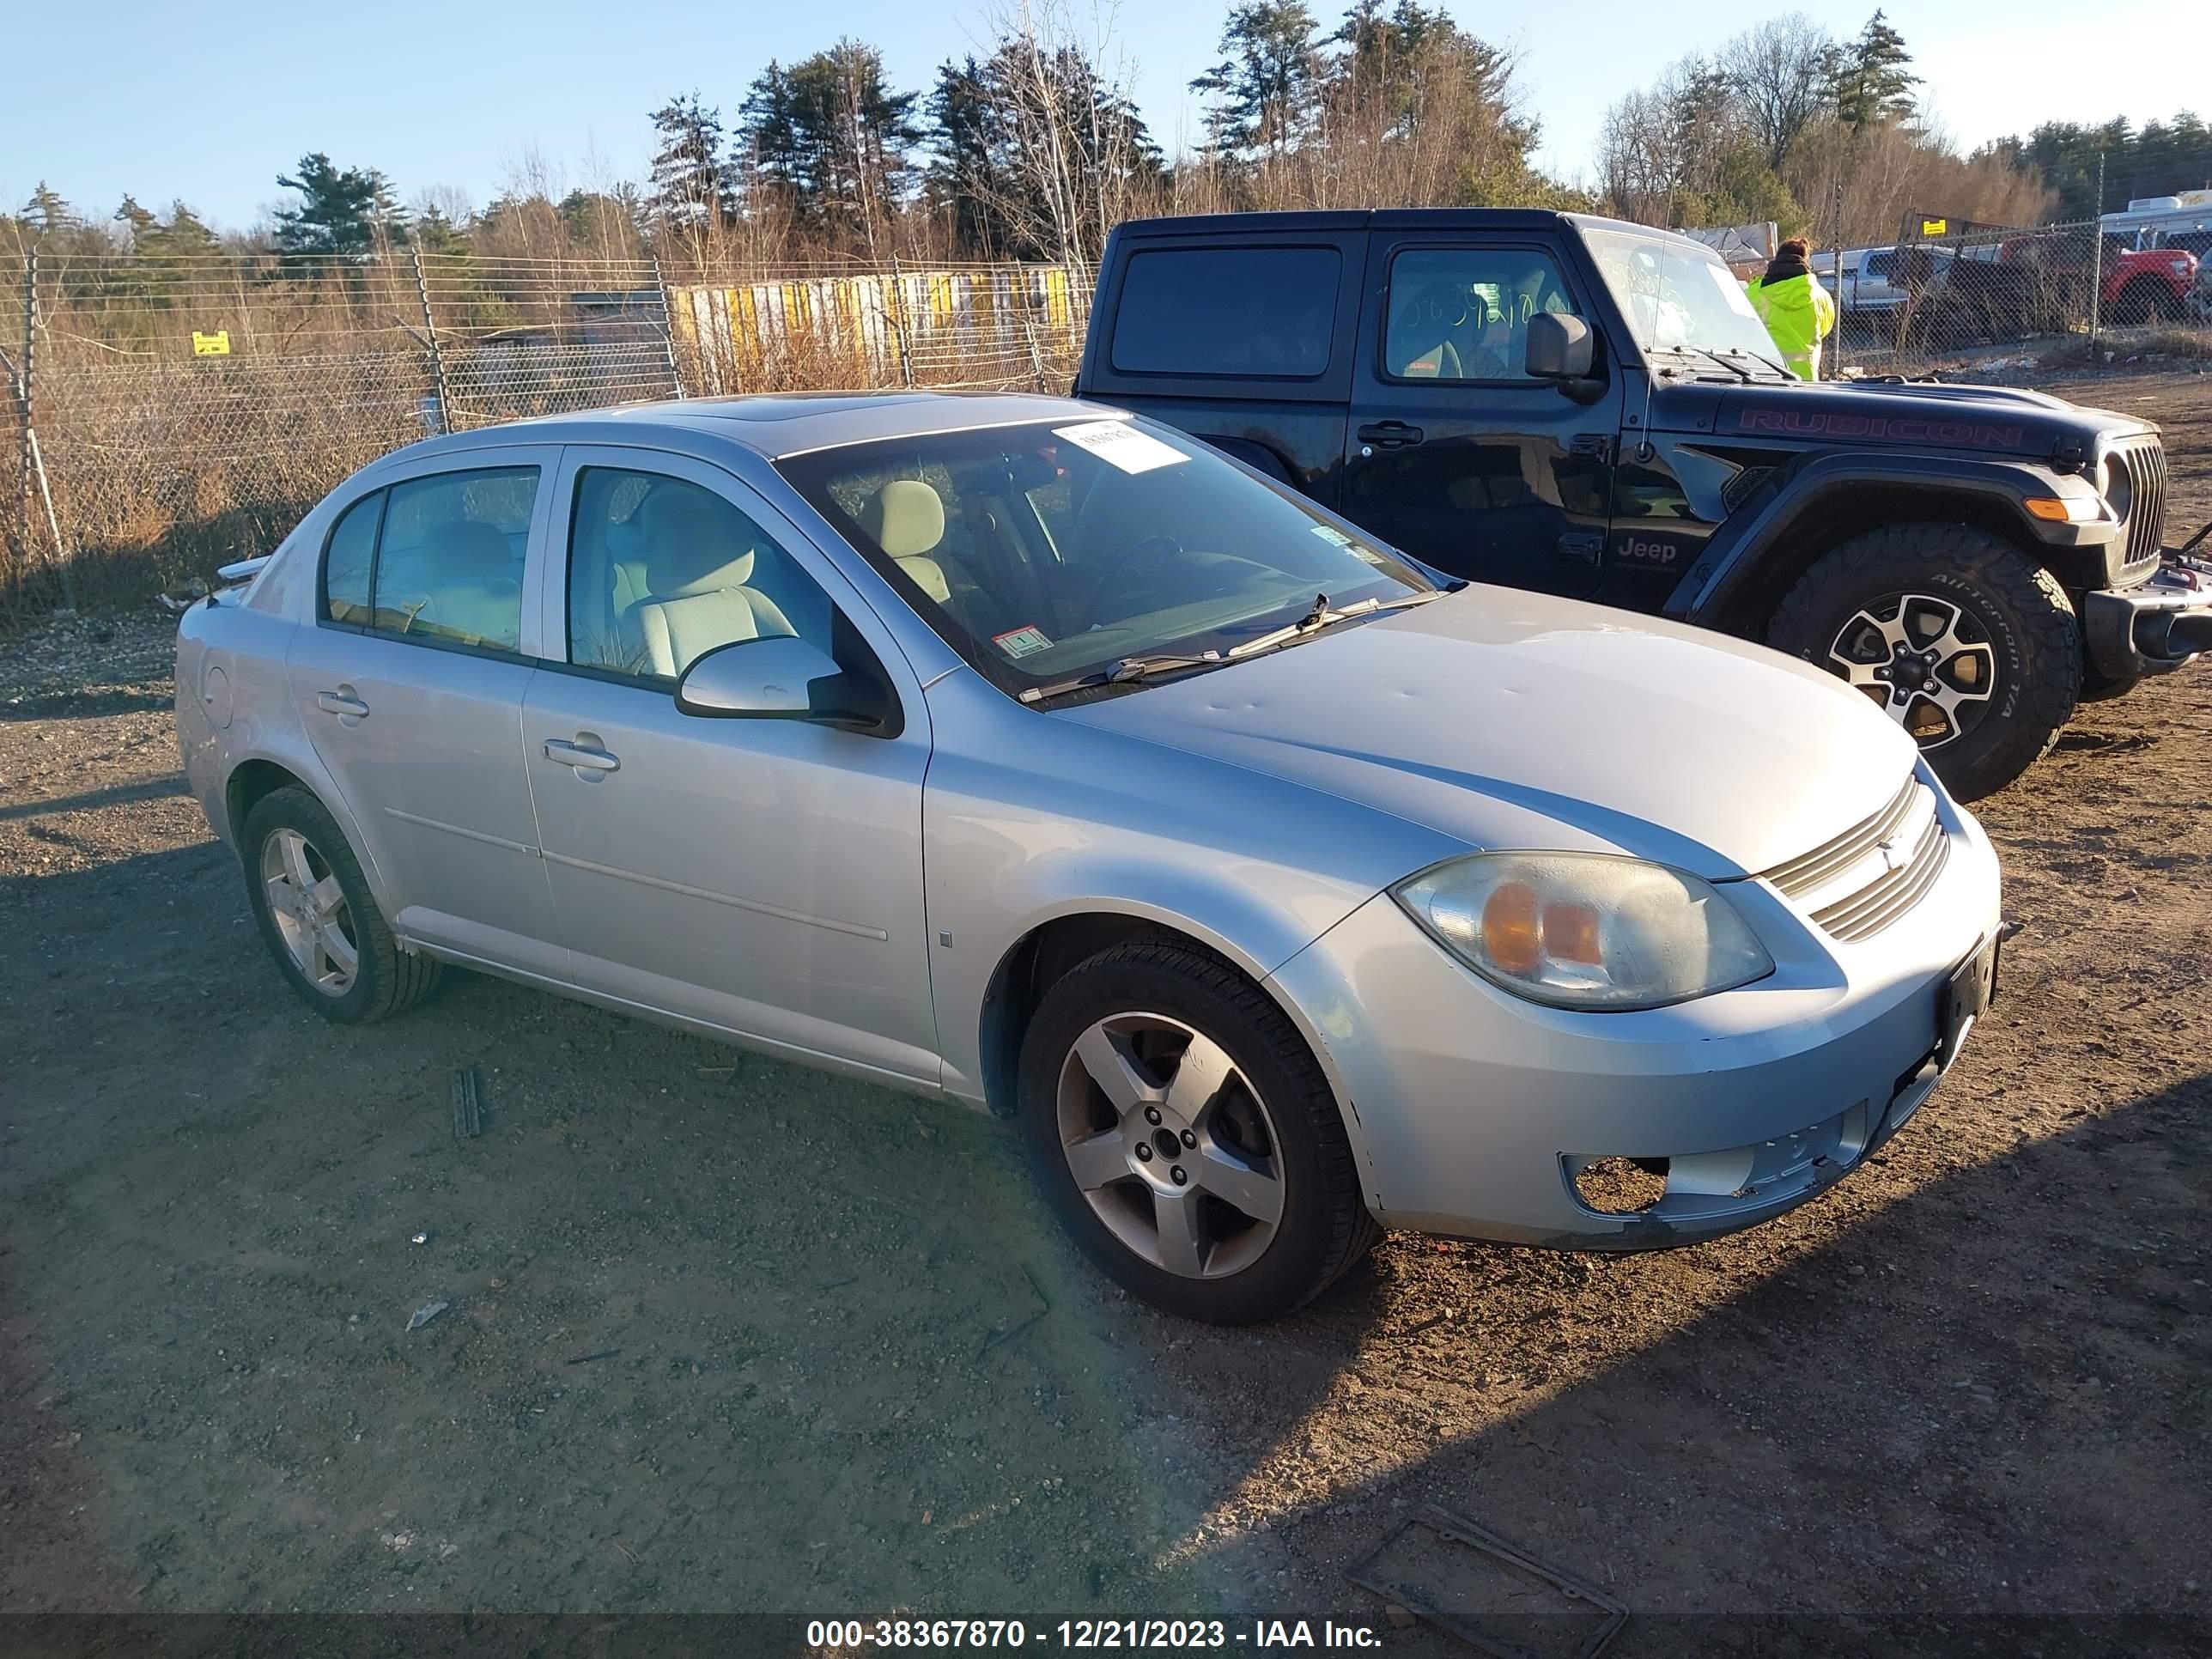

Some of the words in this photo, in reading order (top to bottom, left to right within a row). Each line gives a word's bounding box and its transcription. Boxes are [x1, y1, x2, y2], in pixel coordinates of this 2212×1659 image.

[1740, 409, 2023, 446] RUBICON
[1618, 537, 1676, 563] Jeep
[1016, 636, 1027, 645] 1
[1932, 574, 2021, 669] All-Terrain
[2001, 683, 2021, 718] T/A
